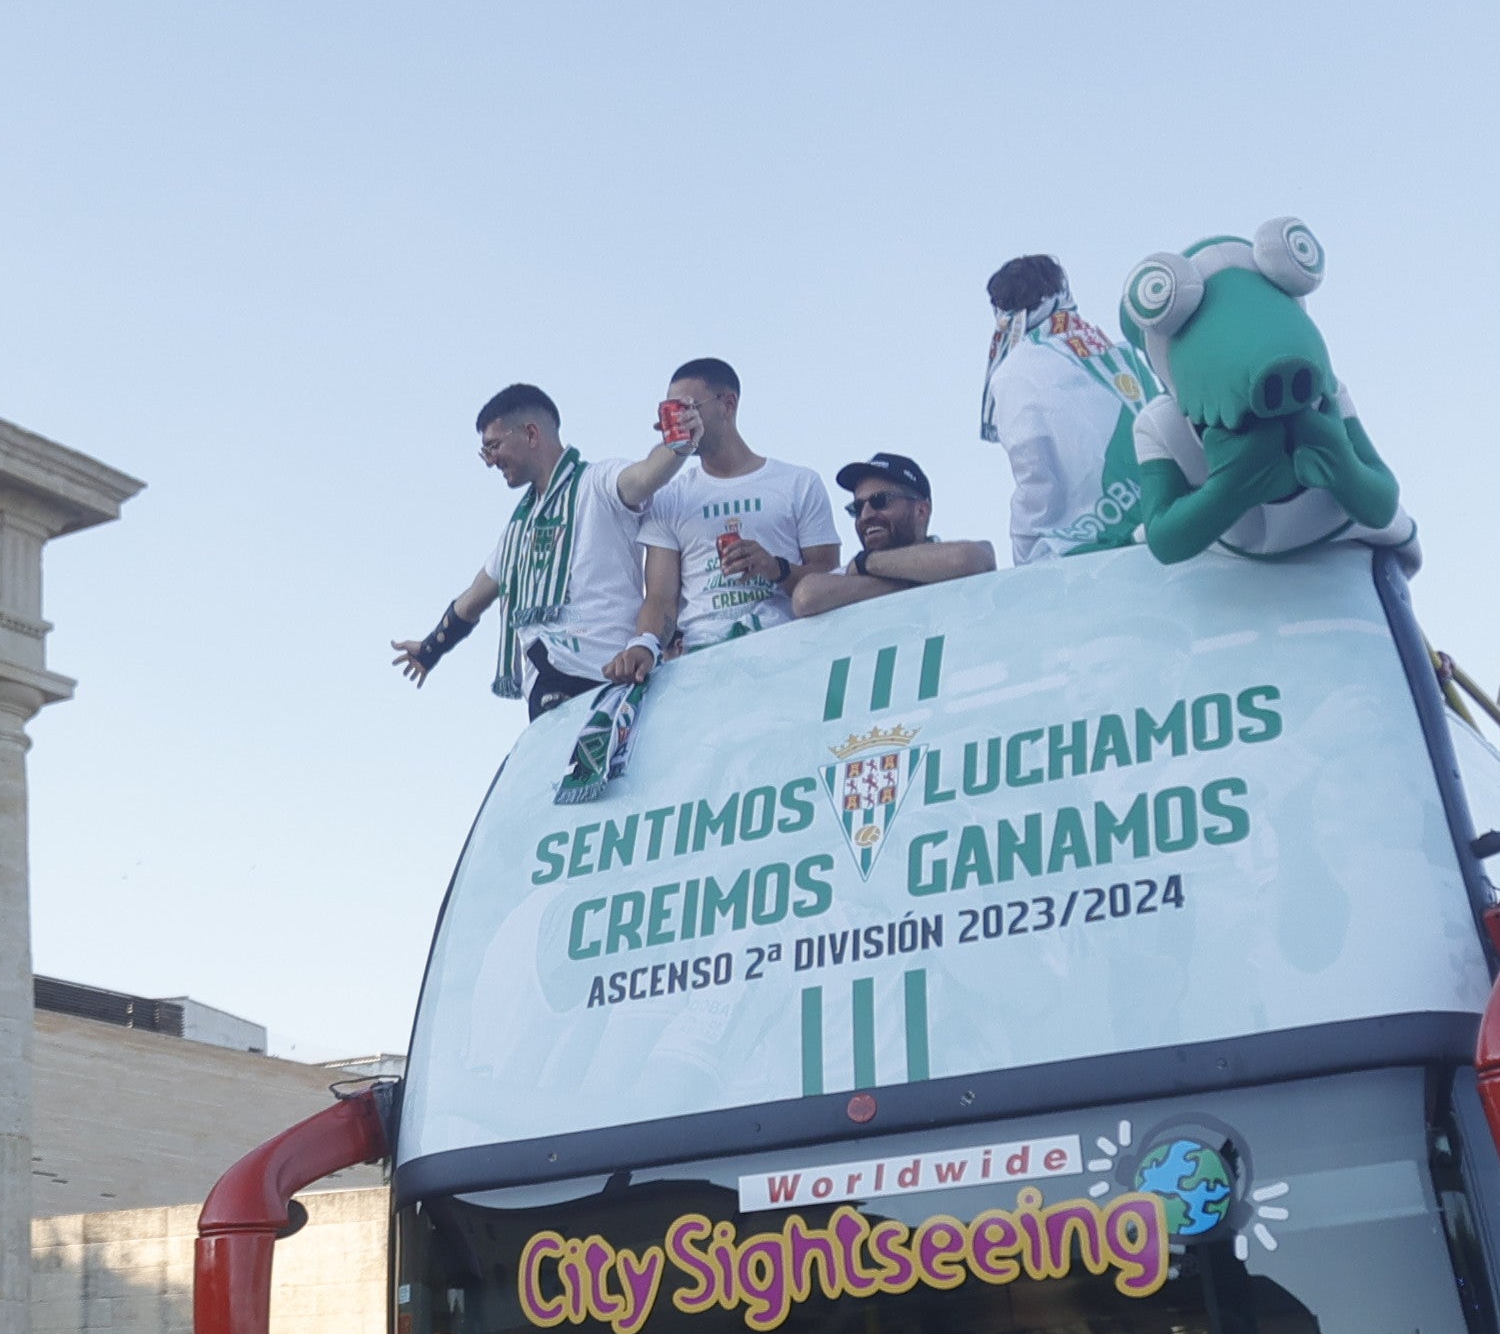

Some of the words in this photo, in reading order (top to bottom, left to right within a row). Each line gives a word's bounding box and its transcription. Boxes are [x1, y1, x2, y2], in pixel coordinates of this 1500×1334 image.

[531, 777, 817, 885] SENTIMOS
[923, 684, 1283, 806] LUCHAMOS
[567, 853, 836, 961] CREIMOS
[907, 777, 1250, 897] GANAMOS
[587, 952, 733, 1008] ASCENSO
[745, 943, 782, 981] 2ª
[794, 911, 944, 972] DIVISIÓN
[958, 873, 1186, 944] 2023/2024
[767, 1145, 1070, 1204] Worldwide
